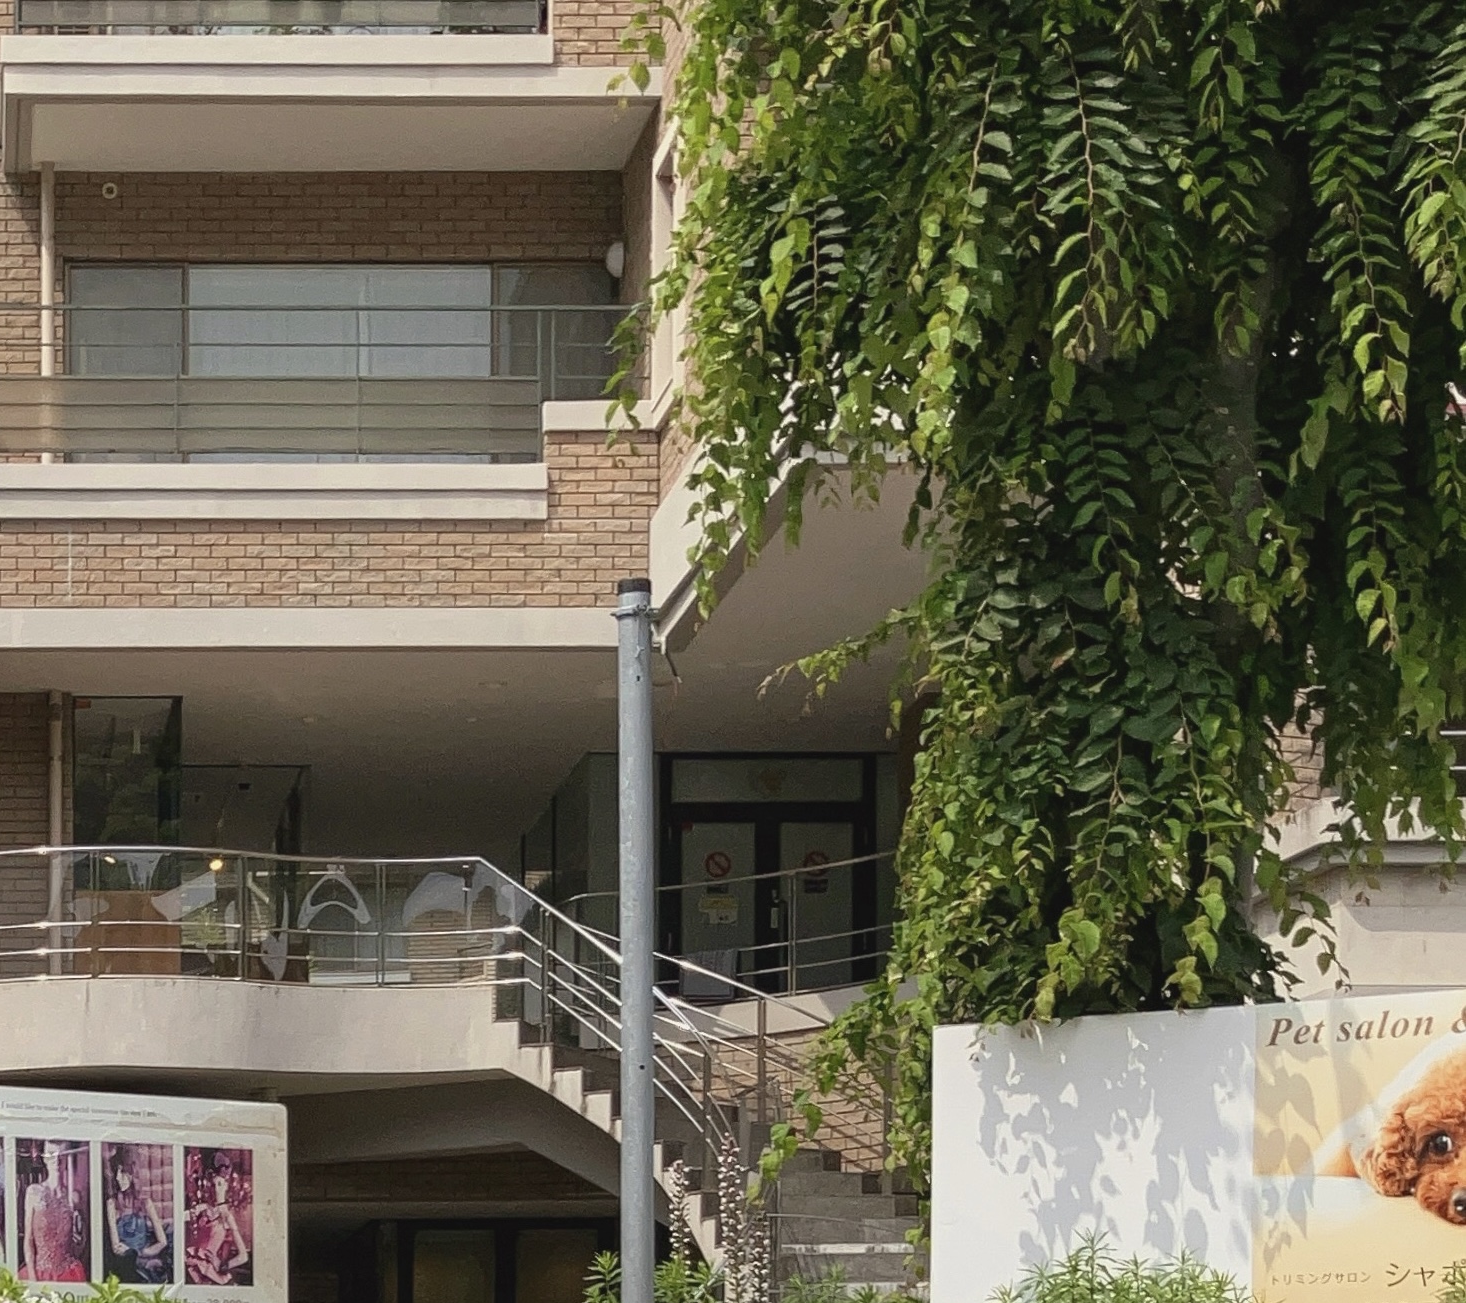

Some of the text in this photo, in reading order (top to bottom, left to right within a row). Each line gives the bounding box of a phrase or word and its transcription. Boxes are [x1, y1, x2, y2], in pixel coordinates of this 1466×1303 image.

[1265, 1018, 1325, 1047] Pet
[1336, 1010, 1434, 1043] salon
[1271, 1271, 1372, 1286] トリミングサロン
